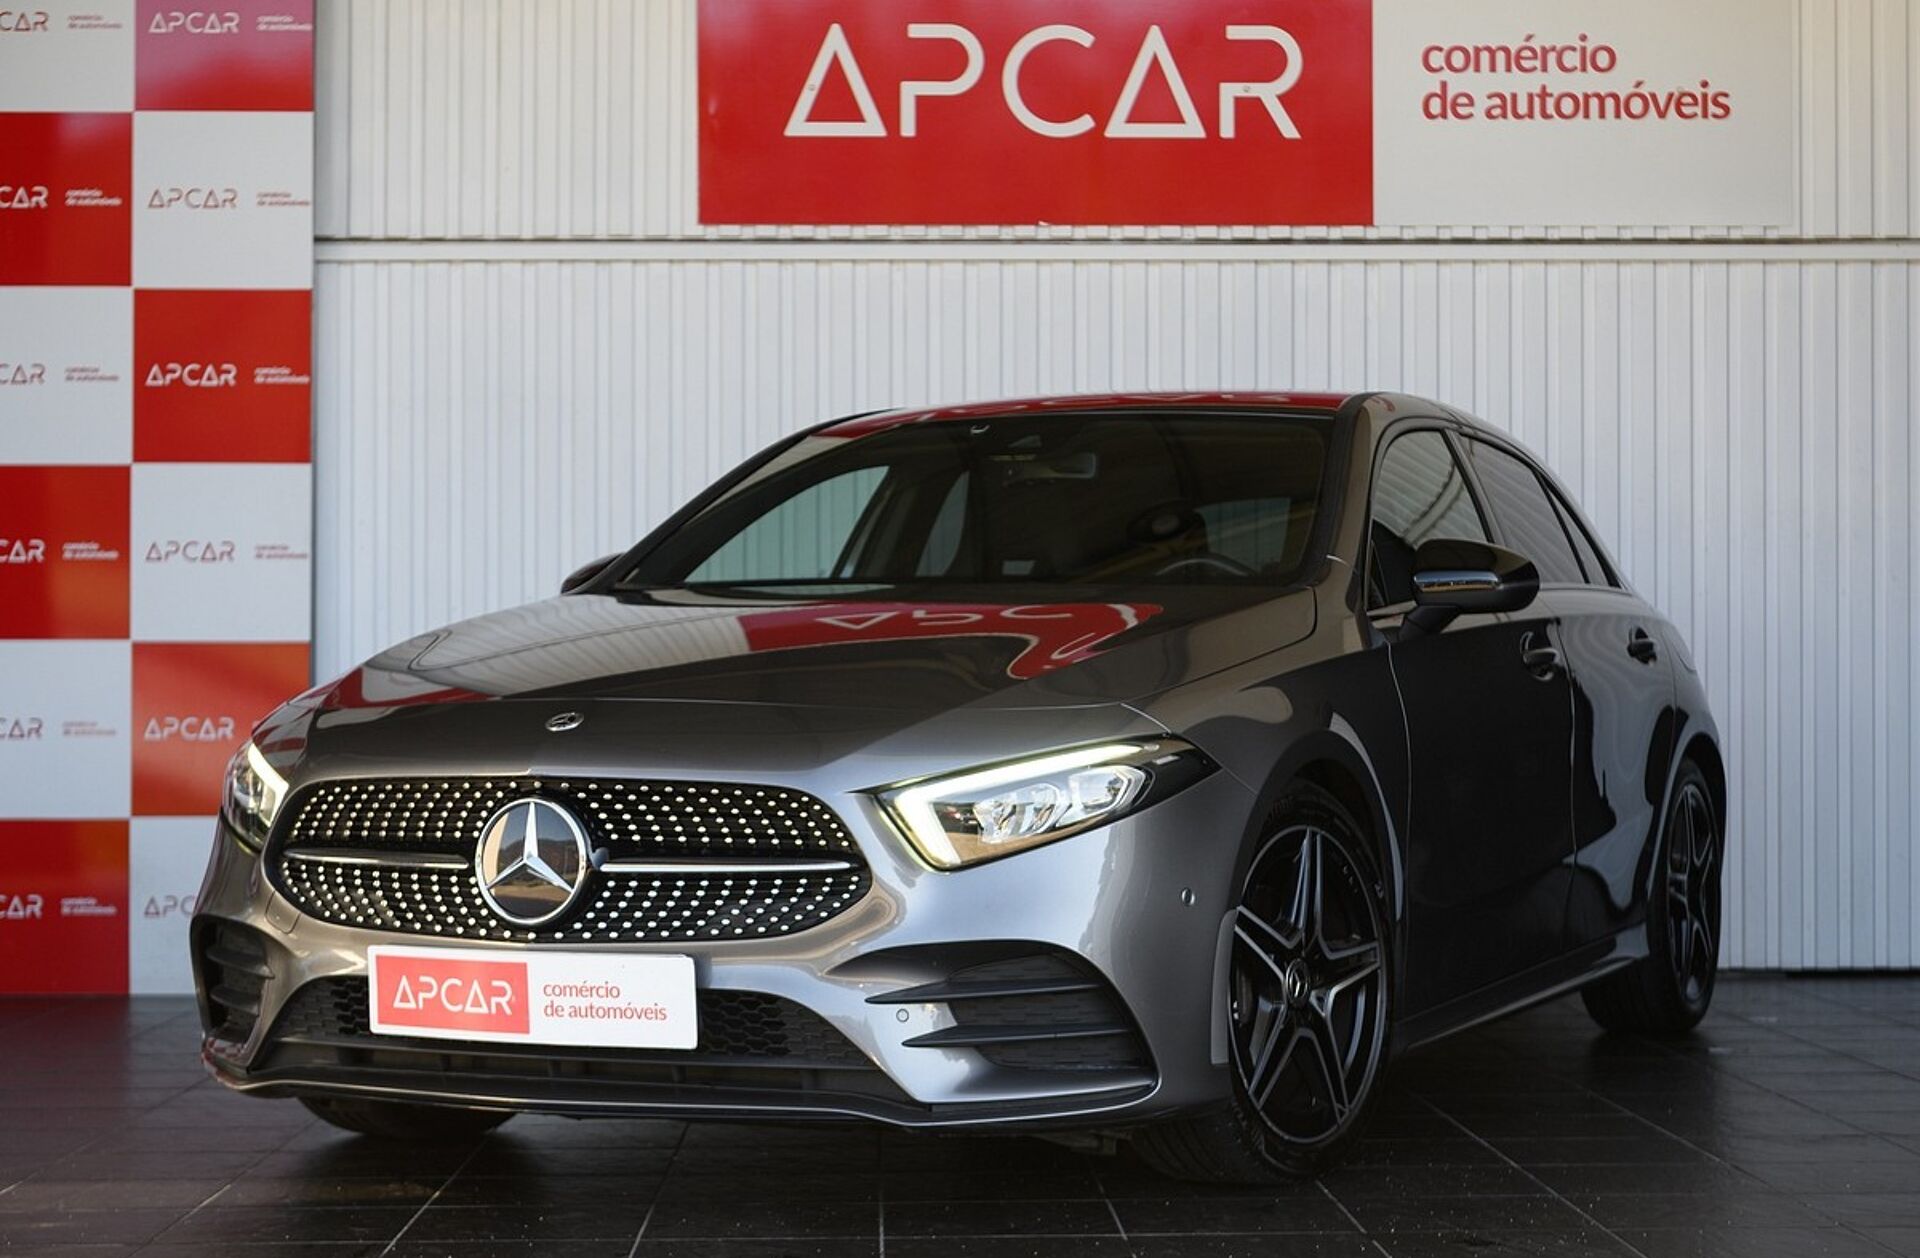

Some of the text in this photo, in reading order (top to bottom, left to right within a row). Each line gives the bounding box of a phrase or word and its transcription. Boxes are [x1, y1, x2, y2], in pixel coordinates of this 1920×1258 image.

[149, 12, 239, 33] APCAR
[1422, 34, 1616, 74] comércio
[783, 23, 1302, 139] APCAR
[1422, 79, 1731, 121] de automóveis
[148, 188, 237, 209] APCAR
[145, 363, 236, 387] APCAR
[146, 541, 235, 562] APCAR
[144, 716, 234, 741] APCAR
[393, 975, 512, 1015] APCAR
[543, 980, 620, 999] comércio
[544, 1000, 668, 1021] de automóveis
